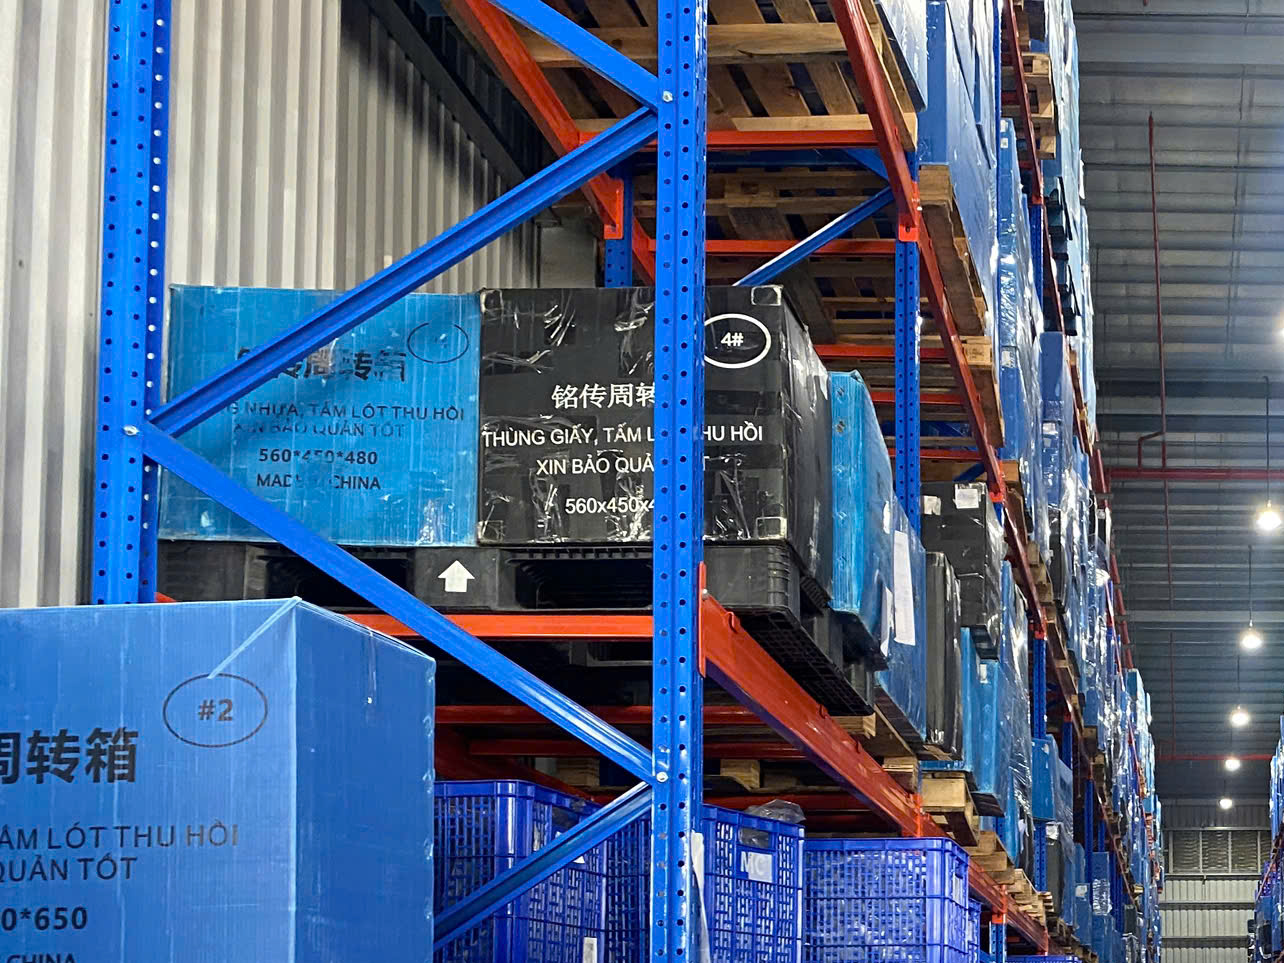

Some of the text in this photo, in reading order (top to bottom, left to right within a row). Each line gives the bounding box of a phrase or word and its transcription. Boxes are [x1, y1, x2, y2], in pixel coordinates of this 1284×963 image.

[721, 332, 744, 347] 4#
[551, 382, 655, 410] 铭传周转
[391, 405, 427, 420] THU
[483, 428, 546, 448] THÙNG
[550, 423, 599, 446] GIẤY,
[602, 422, 642, 444] TẤM
[703, 427, 725, 442] HU
[731, 420, 763, 442] HỒI
[536, 454, 655, 475] XIN BẢO QUẢ
[330, 475, 381, 490] CHINA
[565, 497, 655, 515] 560x450x4
[197, 699, 234, 722] #2
[0, 818, 239, 850] ẤM LÓT THU HỒI
[0, 851, 138, 883] UẢN TỐT
